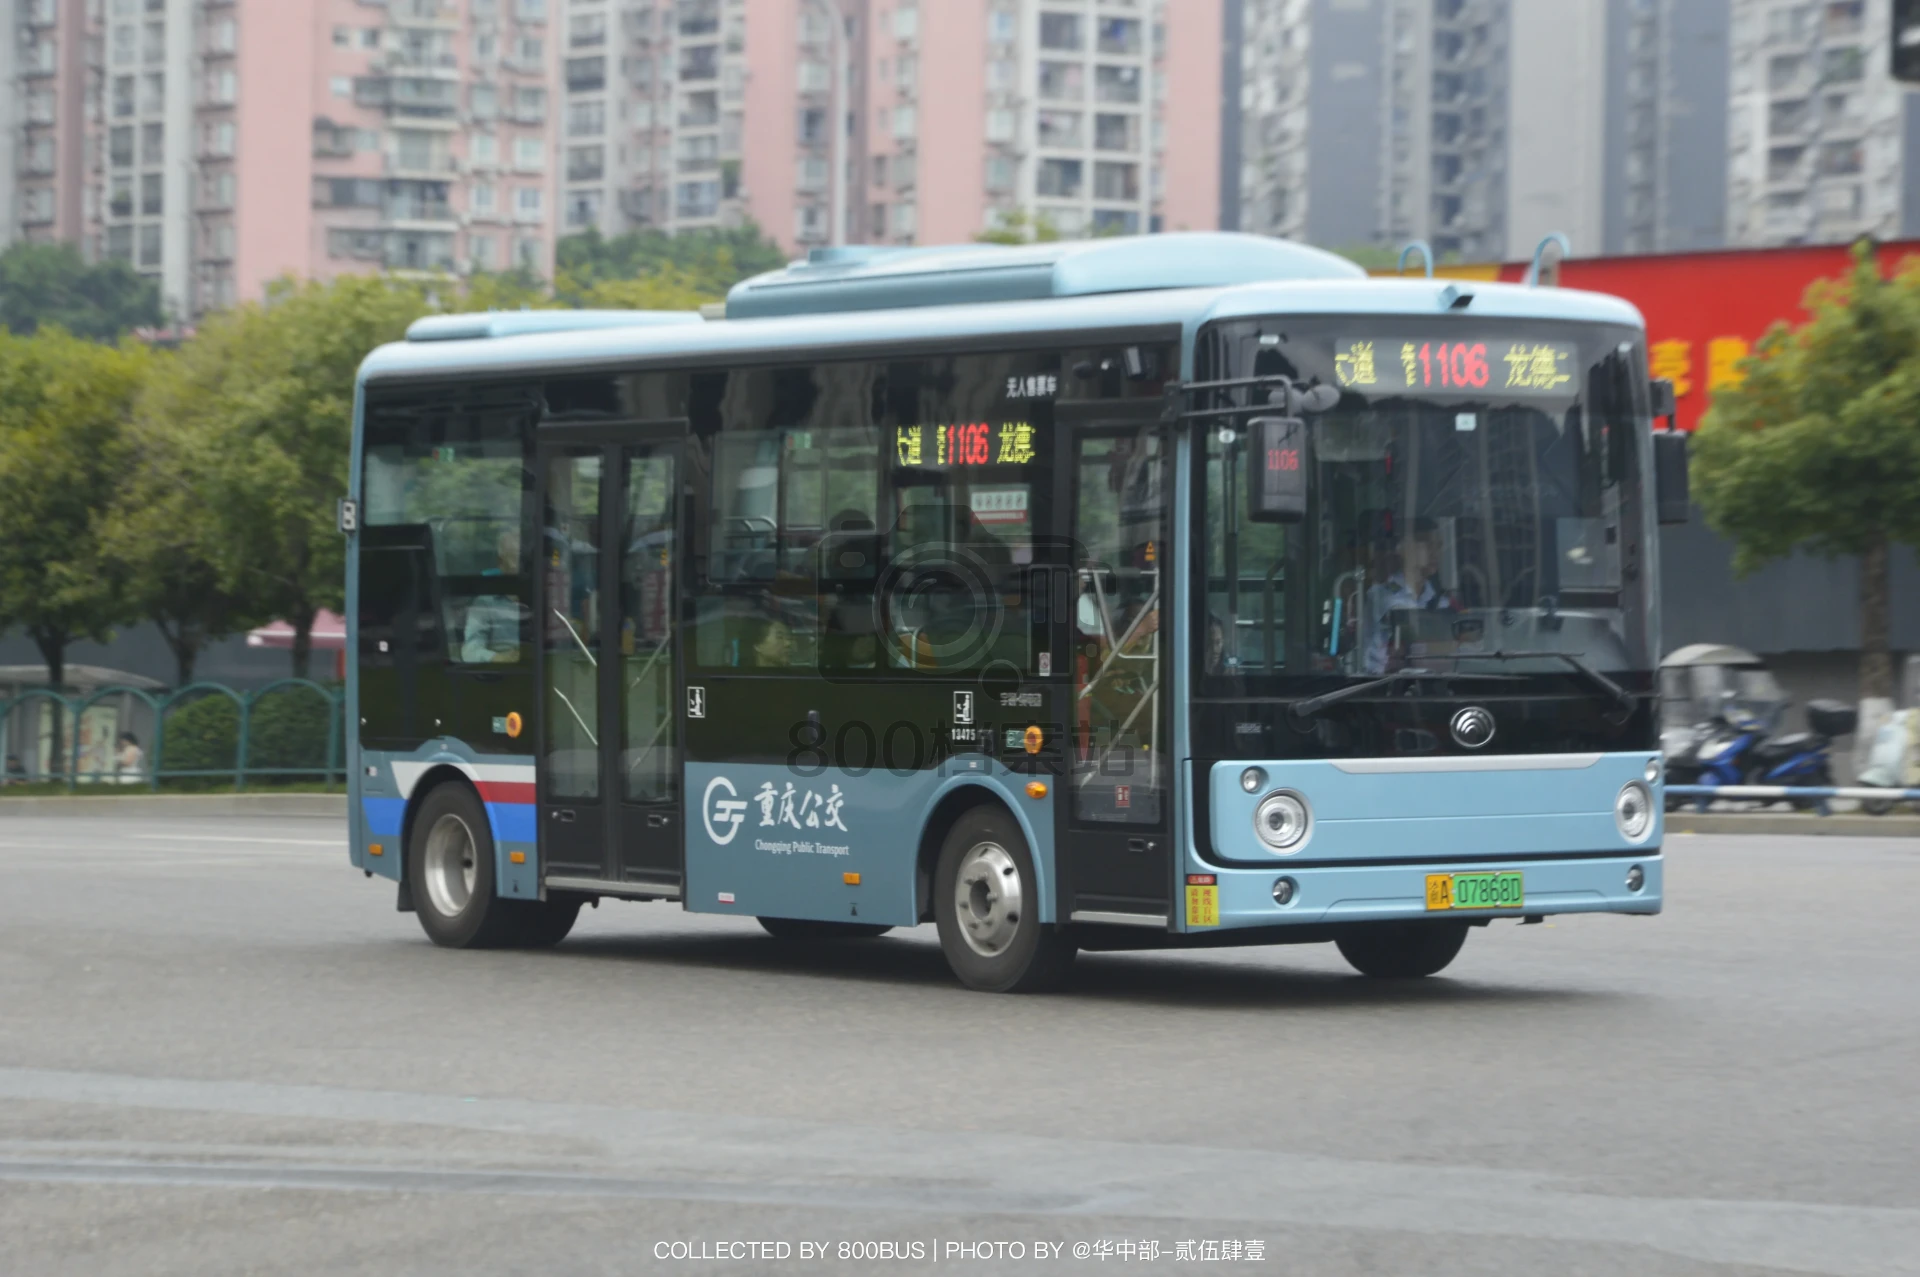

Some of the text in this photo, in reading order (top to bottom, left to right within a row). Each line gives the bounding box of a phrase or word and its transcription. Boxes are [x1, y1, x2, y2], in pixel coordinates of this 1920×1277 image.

[1418, 342, 1489, 388] 1106
[1006, 375, 1057, 398] 无人售票车
[947, 422, 990, 465] 1106
[1267, 449, 1299, 471] 1106
[951, 728, 976, 741] 13475
[754, 781, 848, 832] 重庆公交
[755, 839, 850, 857] Chongqing Public Transport
